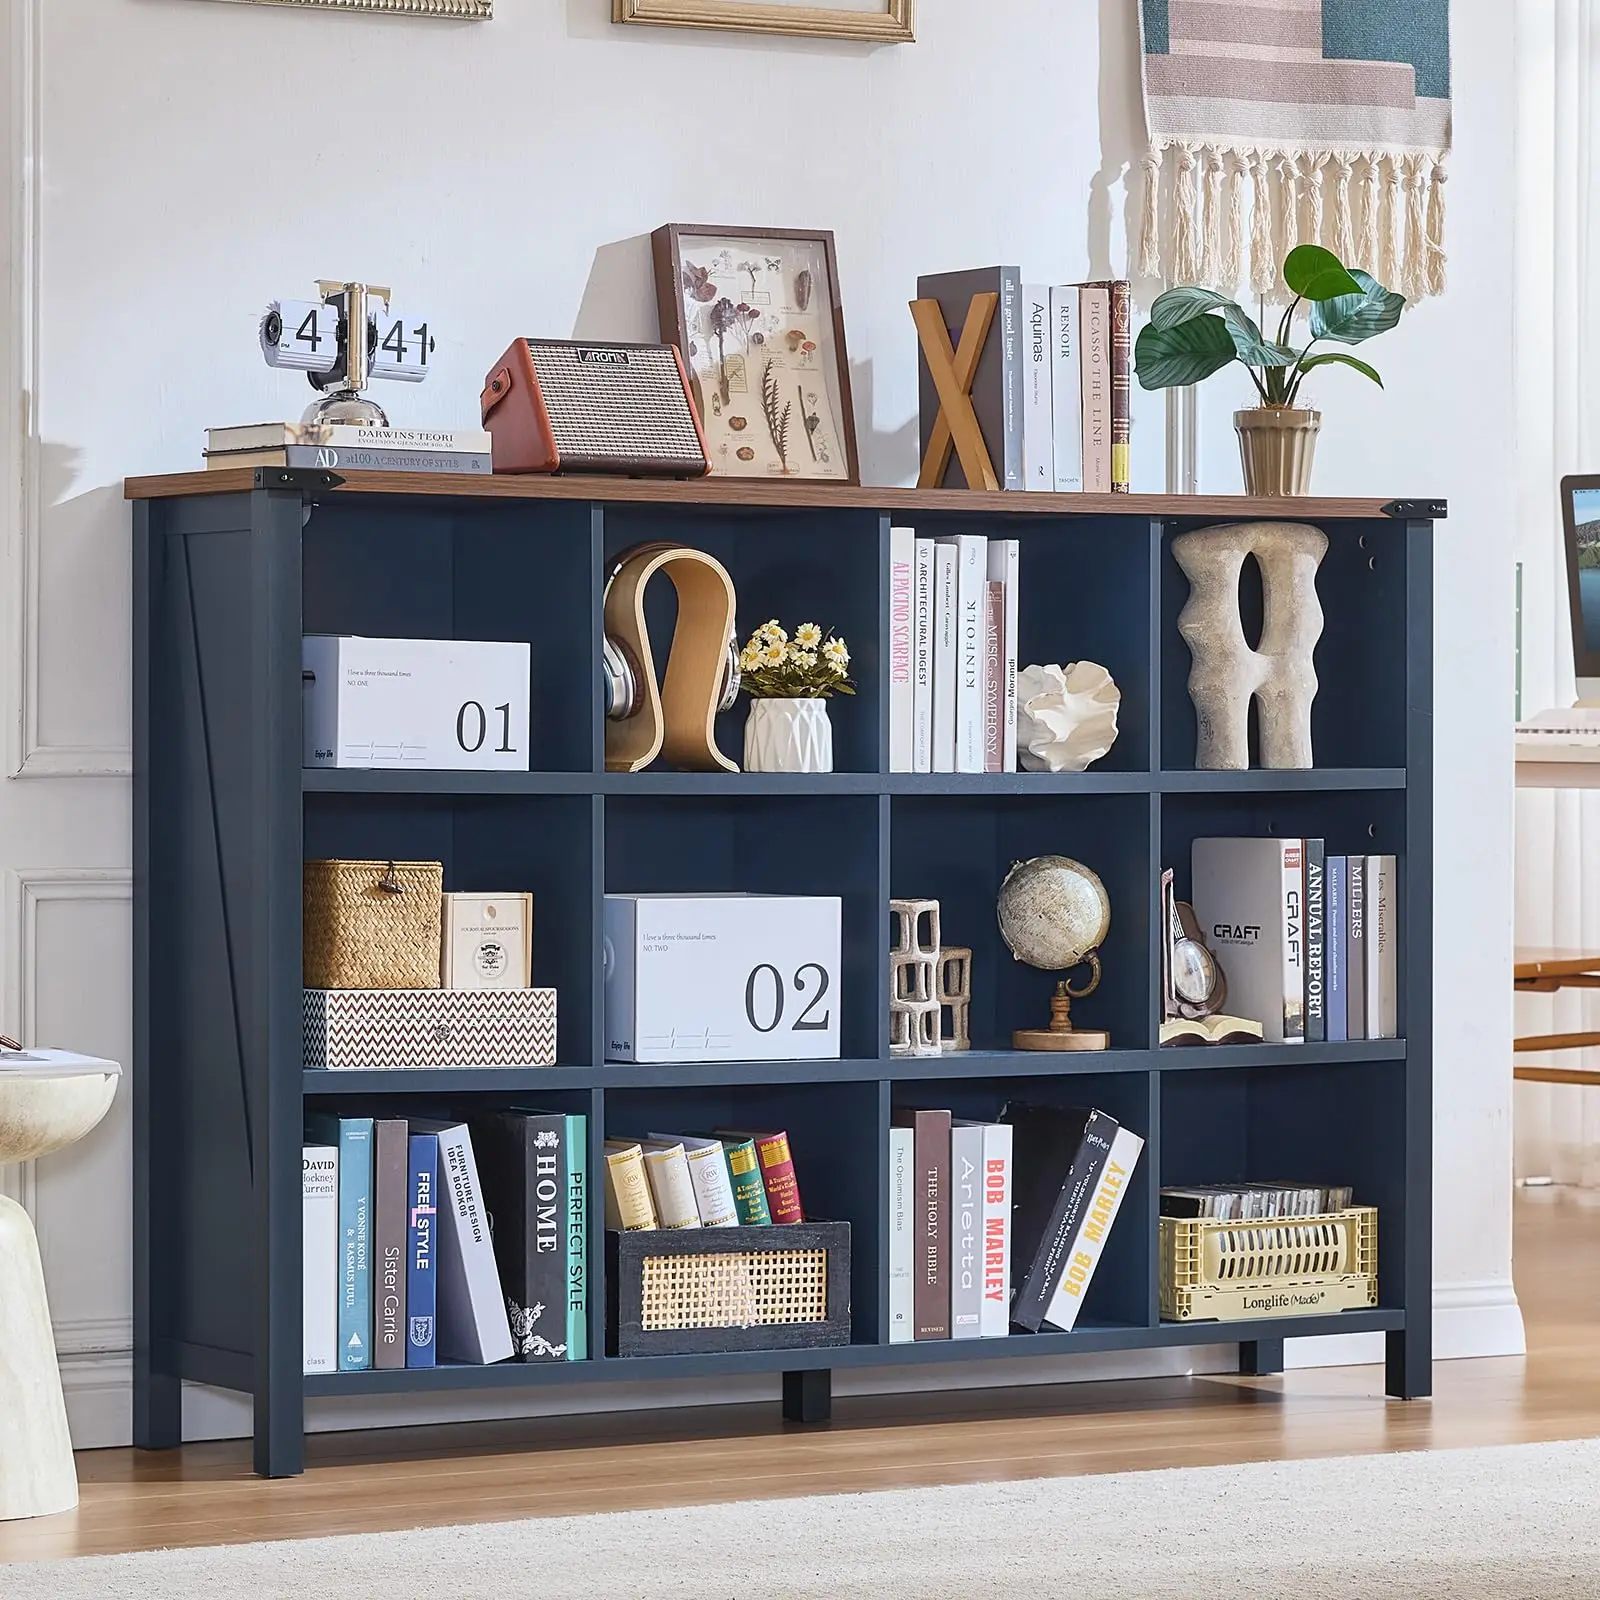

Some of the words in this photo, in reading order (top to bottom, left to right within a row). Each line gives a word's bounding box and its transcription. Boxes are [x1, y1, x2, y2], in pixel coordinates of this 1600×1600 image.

[1005, 279, 1014, 291] all
[1005, 295, 1012, 304] in
[1004, 308, 1015, 334] good
[1030, 302, 1045, 362] Aquinas
[1060, 305, 1070, 358] RENOIR
[1091, 301, 1101, 364] PICASSO
[1006, 337, 1016, 360] taste
[1092, 369, 1101, 401] THE
[358, 429, 414, 440] DARWINS
[417, 432, 454, 442] TEORI
[1092, 408, 1102, 446] LINE
[314, 449, 339, 468] AD
[380, 457, 420, 466] CENTURY
[421, 459, 434, 467] OF
[434, 459, 459, 468] STYLE
[892, 562, 909, 577] AL
[892, 578, 909, 621] PACINO
[919, 562, 928, 647] ARCHITECTURAL
[892, 626, 909, 684] SCARFACE
[966, 600, 976, 688] KINFOLK
[987, 625, 998, 667] MUSIC
[918, 649, 927, 686] DIGEST
[1007, 658, 1015, 697] Morandi
[456, 700, 517, 753] 01
[987, 680, 998, 755] SYMPHONY
[1309, 862, 1323, 940] ANNUAL
[1378, 872, 1386, 891] Les
[1352, 866, 1362, 939] MILLERS
[1213, 924, 1261, 940] CRAFT
[1287, 890, 1300, 967] CRAFT
[745, 962, 830, 1033] 02
[1308, 943, 1322, 1018] REPORT
[447, 1147, 457, 1172] IDEA
[896, 1146, 904, 1164] The
[303, 1184, 334, 1193] urrent
[455, 1144, 474, 1203] FURNITURE
[468, 1204, 482, 1243] DESIGN
[927, 1166, 937, 1197] THE
[986, 1159, 1004, 1204] BOB
[1070, 1181, 1082, 1204] THEN
[536, 1154, 557, 1253] HOME
[570, 1172, 582, 1260] PERFECT
[896, 1211, 904, 1231] Bias
[927, 1200, 937, 1239] HOLY
[1057, 1210, 1070, 1236] WANT
[347, 1228, 355, 1237] &
[416, 1218, 430, 1270] STYLE
[1053, 1236, 1061, 1247] TO
[1055, 1225, 1071, 1259] RAISING
[1062, 1251, 1093, 1297] BOB
[1083, 1160, 1127, 1244] MARLEY
[346, 1242, 355, 1282] RASMUS
[384, 1247, 400, 1291] Sister
[927, 1246, 937, 1285] BIBLE
[985, 1218, 1004, 1302] MARLEY
[570, 1265, 583, 1311] SYLE
[1243, 1294, 1289, 1310] Longlife
[384, 1295, 399, 1344] Carrie
